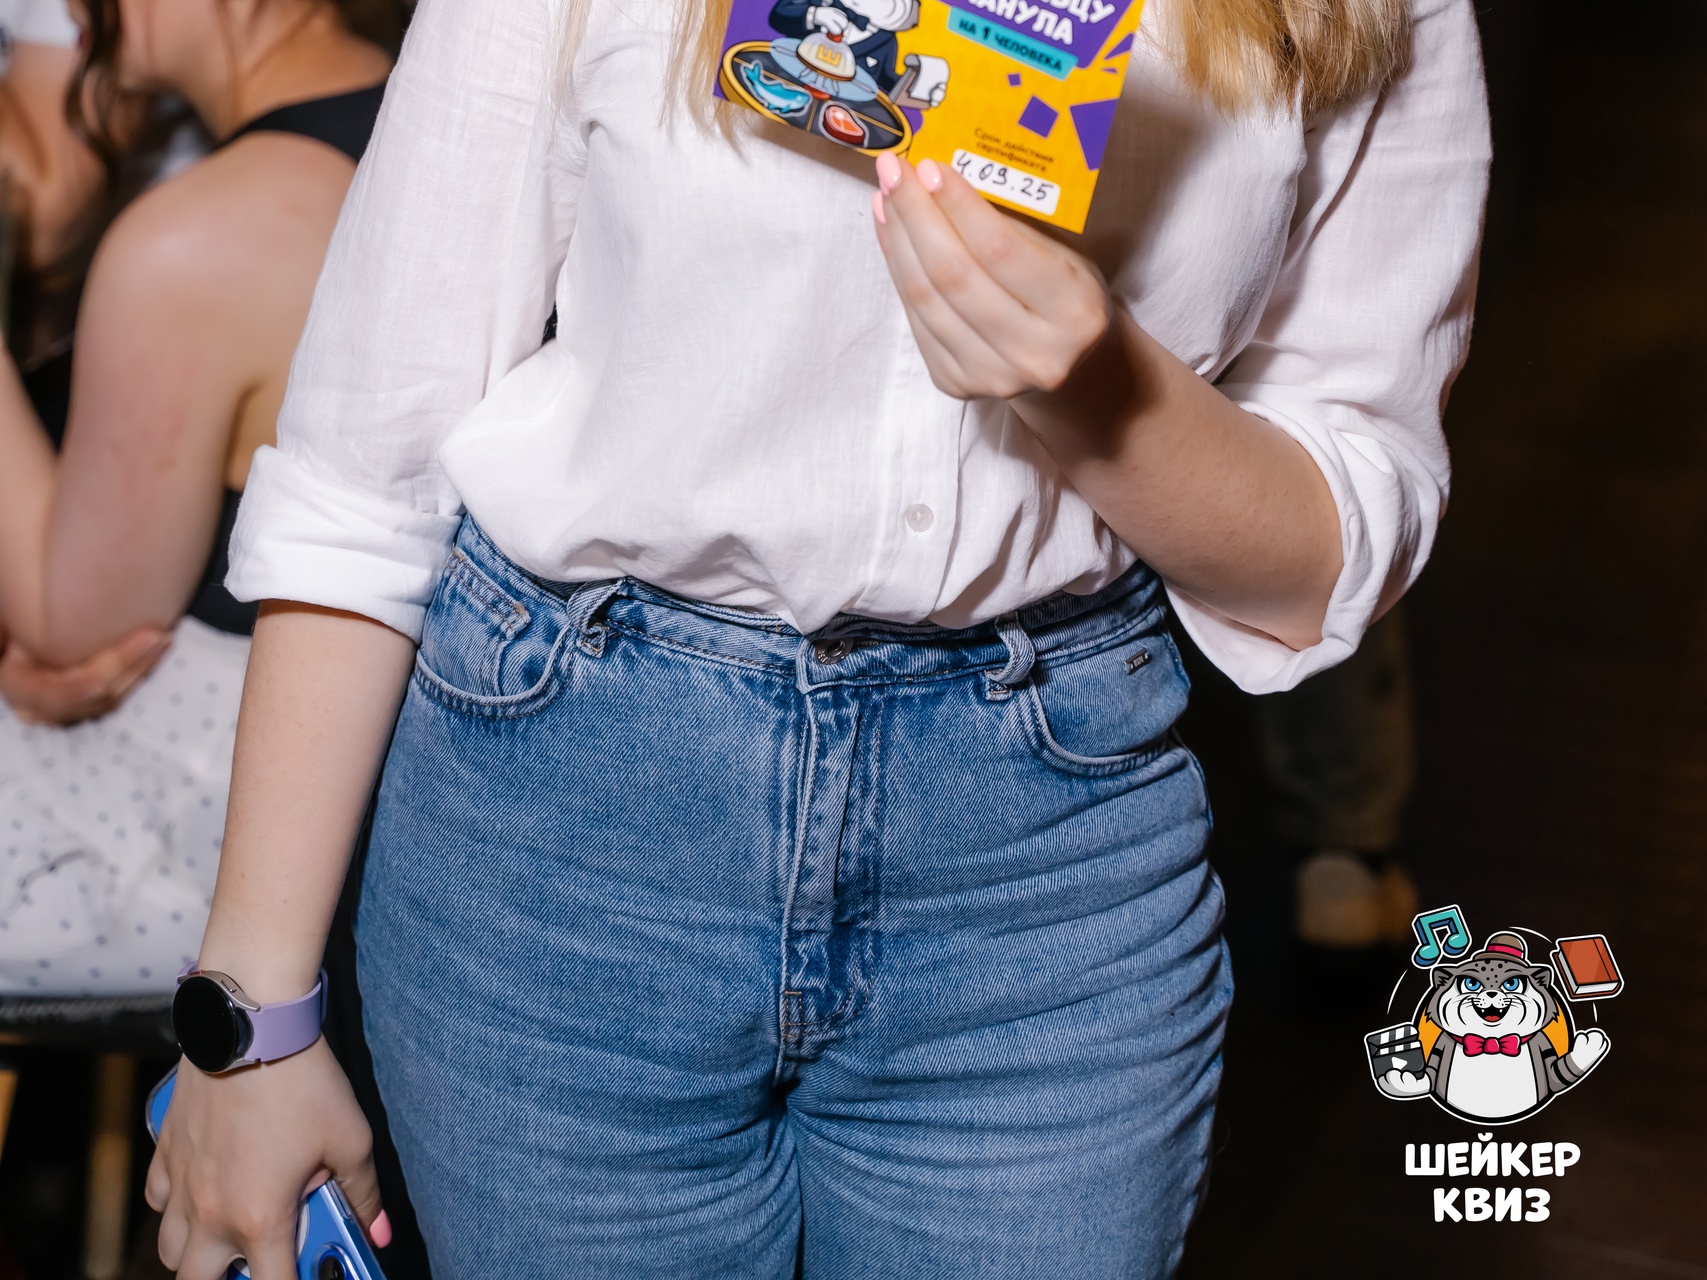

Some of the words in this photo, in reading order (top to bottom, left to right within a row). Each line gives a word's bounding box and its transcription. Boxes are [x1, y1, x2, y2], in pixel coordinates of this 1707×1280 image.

[958, 18, 977, 36] НА
[982, 26, 992, 40] 1
[995, 32, 1063, 72] ЧЕЛОВЕКА
